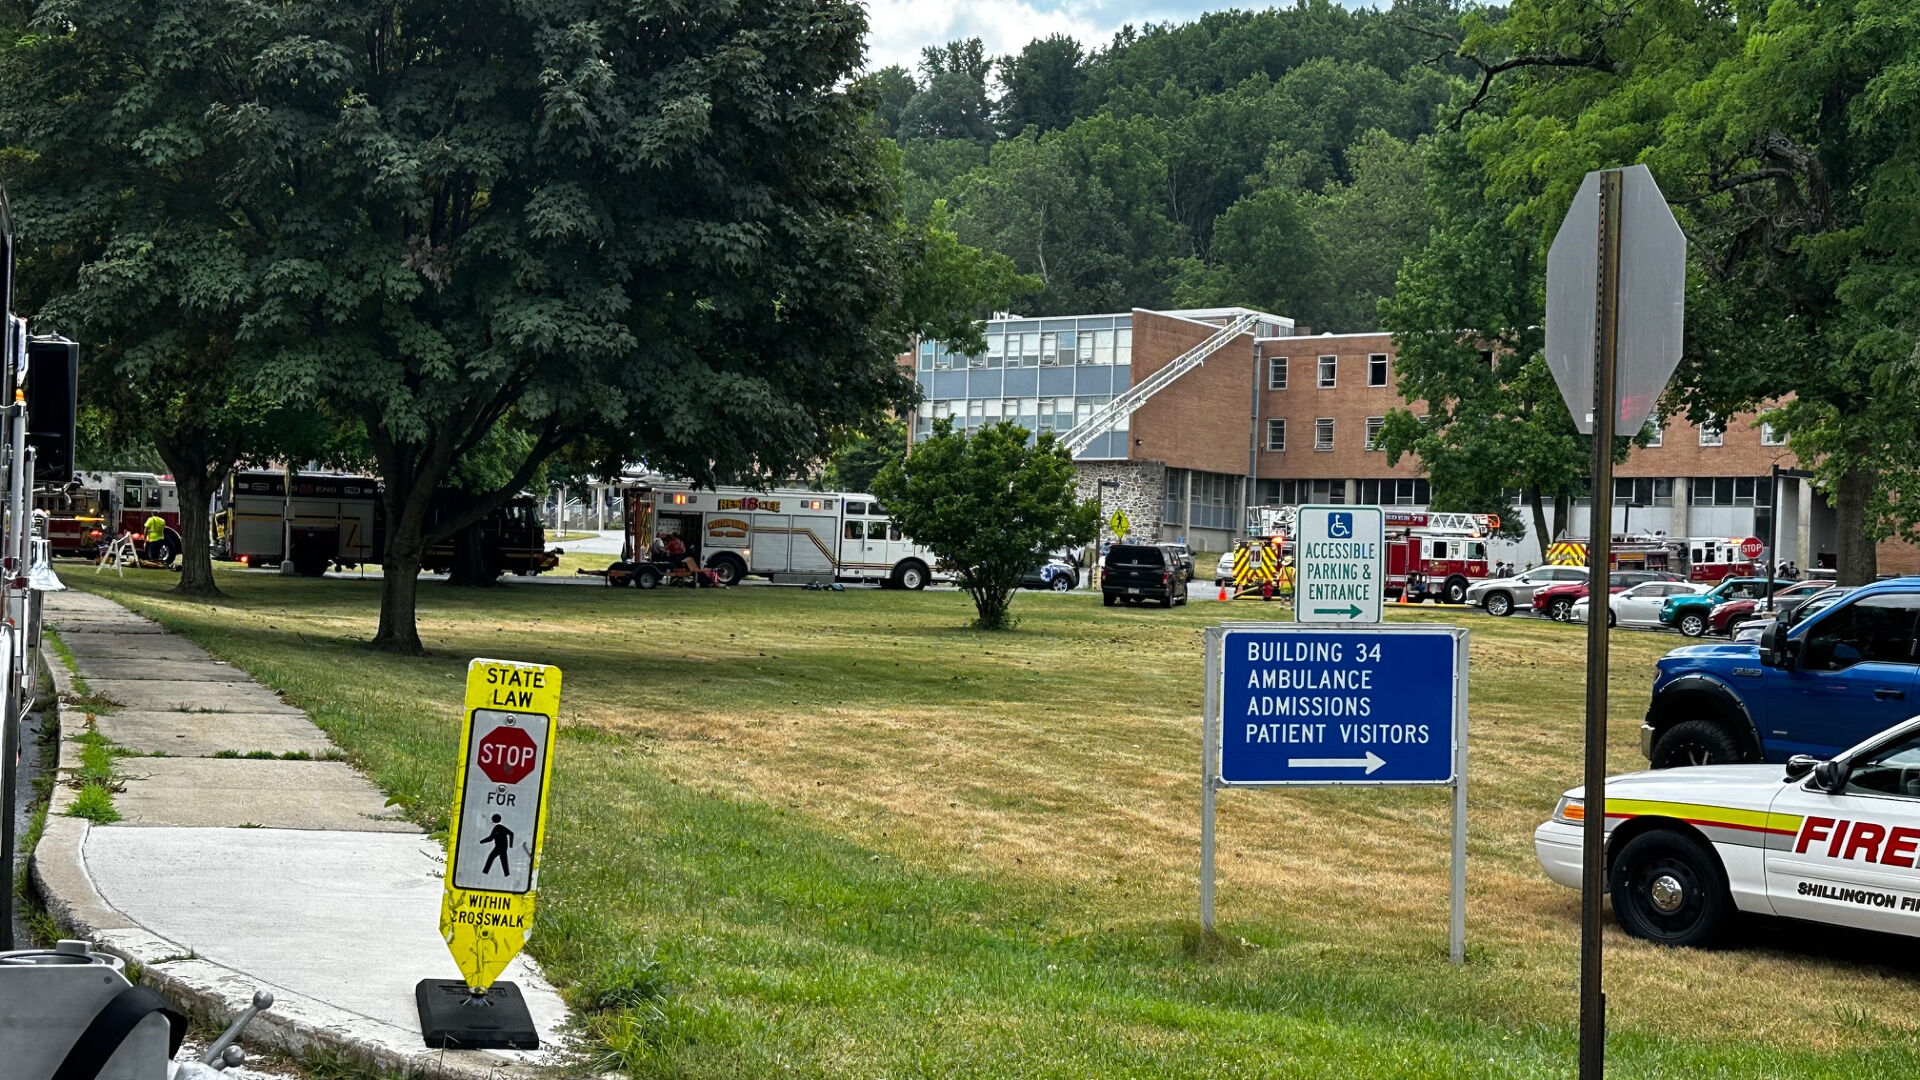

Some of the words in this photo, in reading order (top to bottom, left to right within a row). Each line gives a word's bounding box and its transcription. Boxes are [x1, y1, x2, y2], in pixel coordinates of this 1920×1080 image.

[1305, 543, 1375, 559] ACCESSIBLE
[1742, 544, 1761, 552] STOP
[1307, 563, 1359, 580] PARKING
[1363, 565, 1372, 580] &
[1309, 584, 1370, 600] ENTRANCE
[1248, 642, 1343, 662] BUILDING
[1355, 643, 1381, 662] 34
[487, 668, 545, 689] STATE
[1248, 670, 1372, 689] AMBULANCE
[493, 689, 533, 708] LAW
[1247, 697, 1371, 716] ADMISSIONS
[1246, 724, 1326, 743] PATIENT
[1340, 725, 1429, 744] VISITORS
[481, 743, 533, 767] STOP
[487, 792, 516, 806] FOR
[1795, 816, 1920, 868] FIRE
[469, 895, 511, 911] WITHIN
[1798, 882, 1897, 909] SHILLINGTON
[451, 910, 525, 928] CROSSWALK
